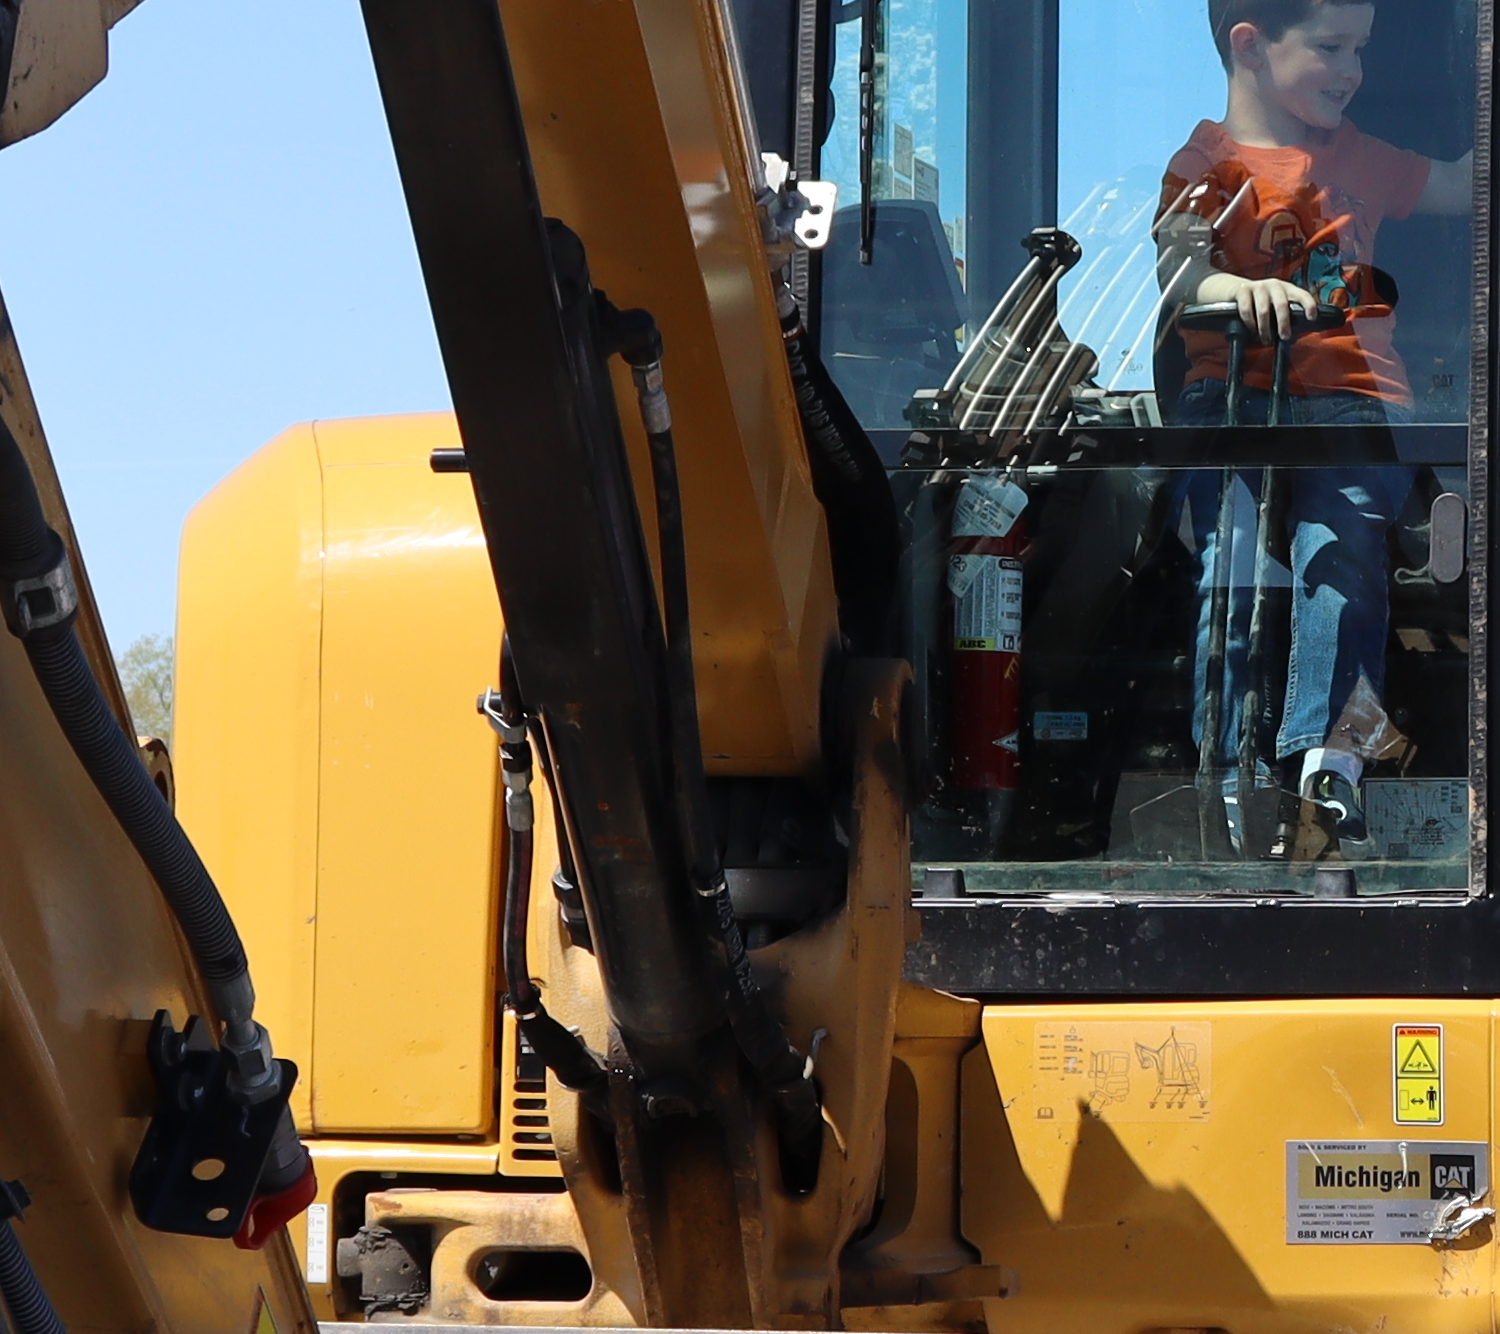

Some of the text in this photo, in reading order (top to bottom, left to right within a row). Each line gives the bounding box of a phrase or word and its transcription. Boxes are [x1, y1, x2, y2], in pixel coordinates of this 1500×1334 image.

[959, 639, 986, 648] ABC
[1315, 1165, 1472, 1193] Michigan CAT
[1297, 1230, 1374, 1239] 888 MICH CAT
